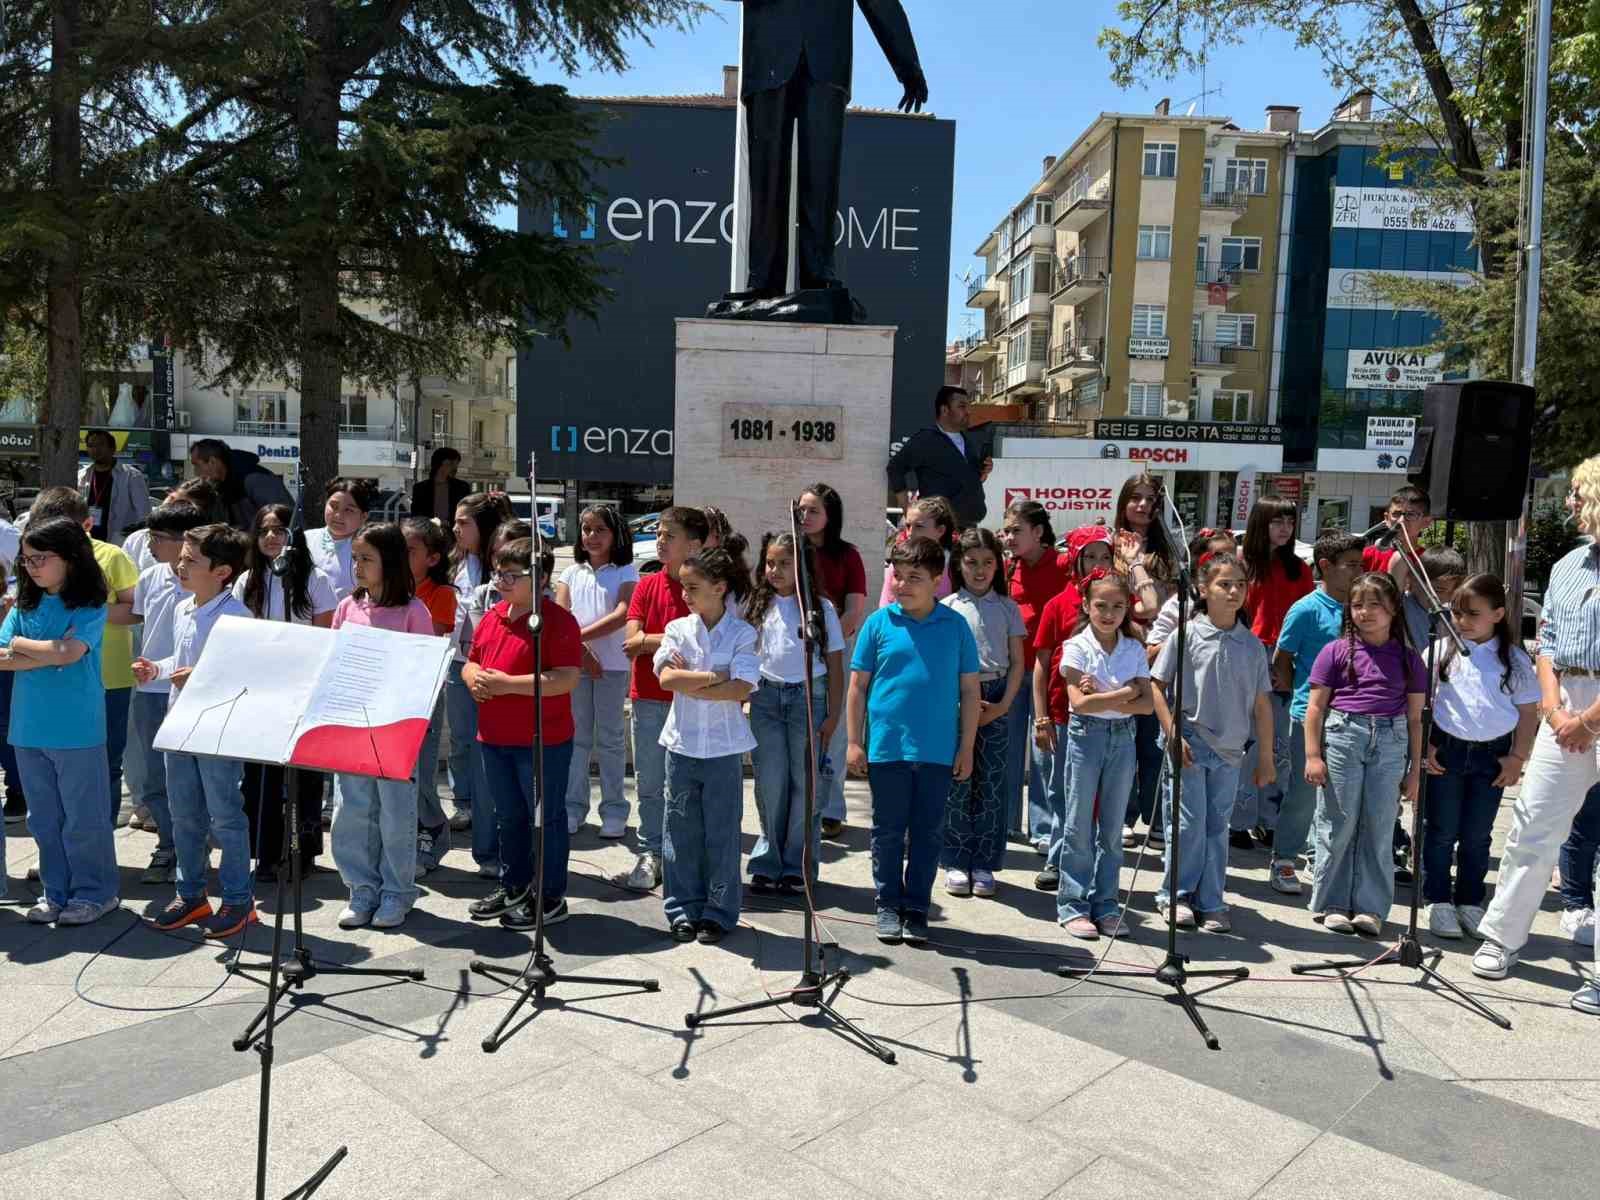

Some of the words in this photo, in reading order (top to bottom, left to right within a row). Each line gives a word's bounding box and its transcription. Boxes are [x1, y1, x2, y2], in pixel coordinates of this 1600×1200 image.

[835, 206, 920, 251] ME
[1383, 216, 1408, 228] 0555
[1432, 218, 1456, 230] 4626
[1363, 352, 1426, 366] AVUKAT
[730, 418, 774, 441] 1881
[791, 420, 836, 443] 1938
[583, 426, 673, 456] enza
[1128, 447, 1187, 463] BOSCH
[1035, 487, 1113, 499] HOROZ
[1236, 480, 1250, 521] BOSCH
[1045, 499, 1112, 511] OJİSTİK
